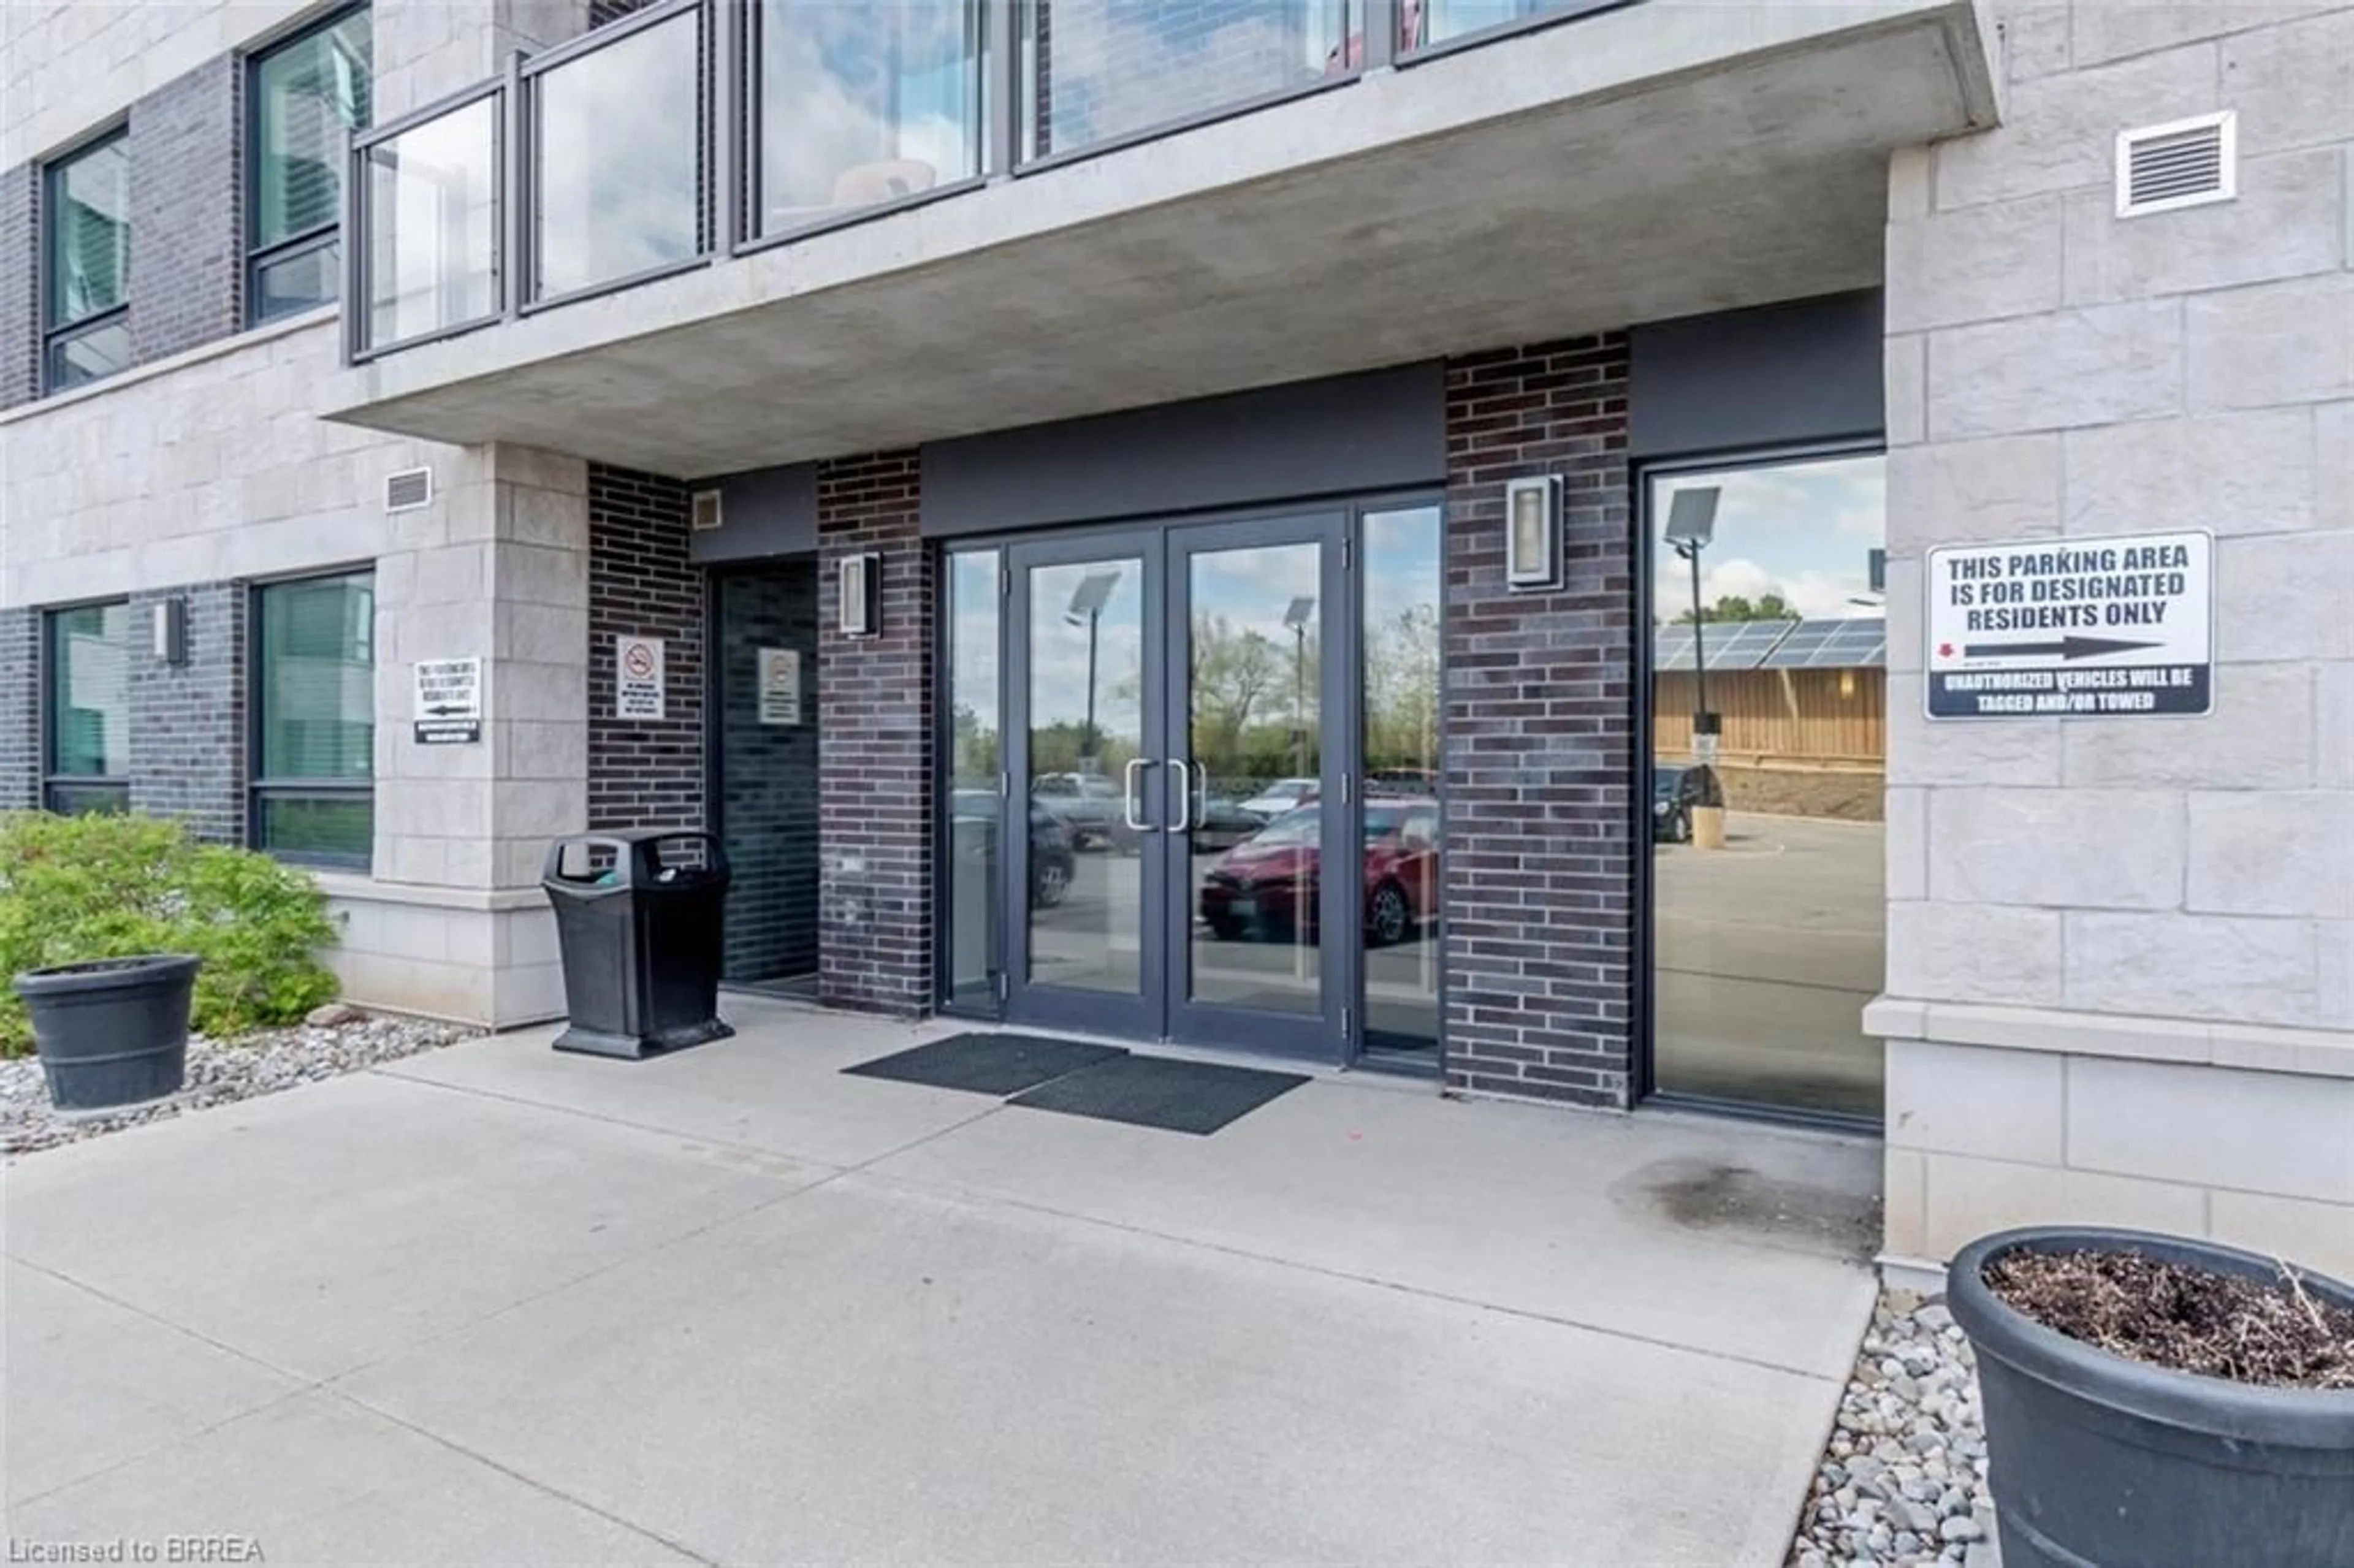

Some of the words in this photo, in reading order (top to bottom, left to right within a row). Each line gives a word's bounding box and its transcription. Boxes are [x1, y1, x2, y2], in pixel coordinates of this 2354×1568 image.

[1948, 557, 2002, 580] THIS
[2008, 549, 2116, 576] PARKING
[2123, 544, 2188, 569] AREA
[1951, 585, 1974, 606] IS
[1981, 581, 2024, 603] FOR
[2031, 573, 2185, 602] DESIGNATED
[1967, 605, 2098, 631] RESIDENTS
[2106, 601, 2167, 625] ONLY
[2056, 669, 2127, 689] VEHICLES
[2128, 669, 2168, 687] WILL
[2170, 668, 2193, 685] BE
[1977, 694, 2034, 712] TAGGED
[2036, 693, 2095, 711] AND/OR
[2098, 691, 2155, 710] TOWED
